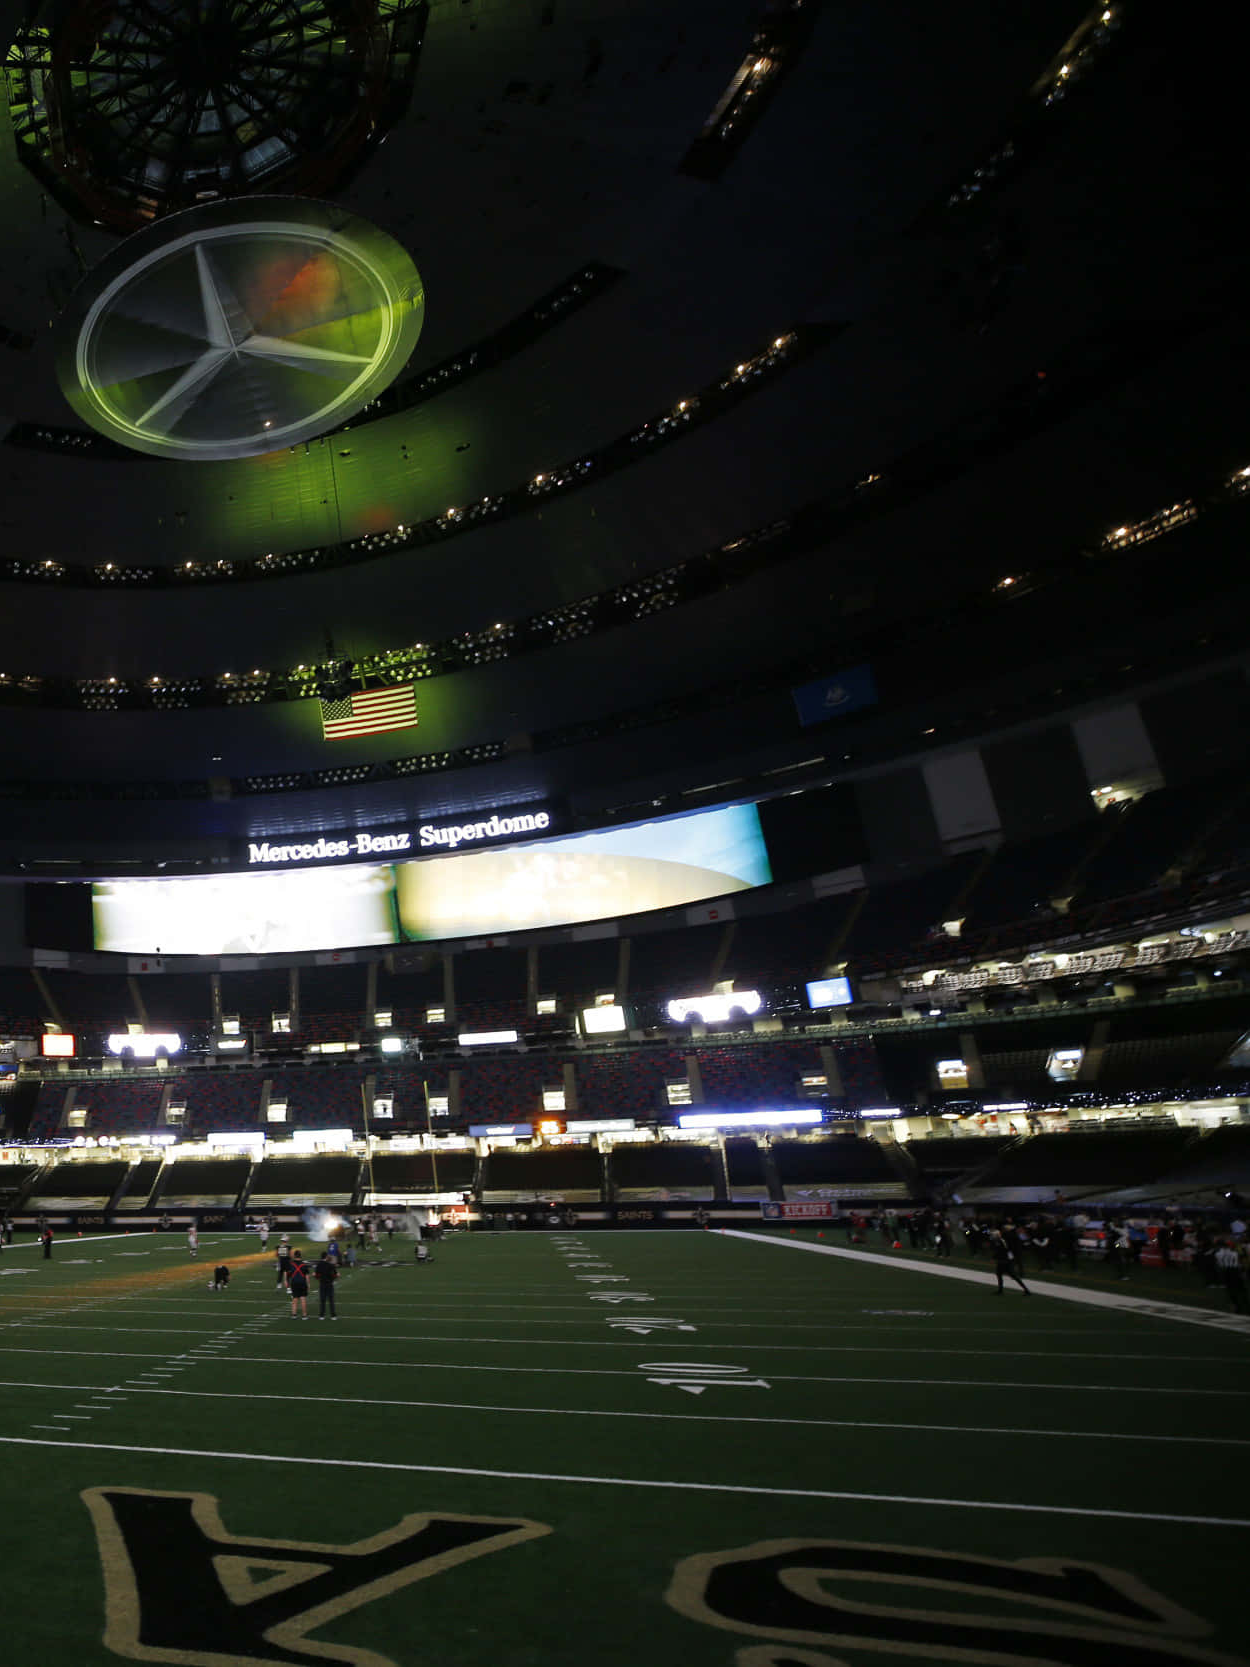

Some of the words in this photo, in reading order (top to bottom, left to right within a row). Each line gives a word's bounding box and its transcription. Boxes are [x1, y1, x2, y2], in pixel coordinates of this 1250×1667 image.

[247, 832, 411, 865] Mercedes-Benz
[418, 811, 550, 847] Superdome
[637, 1362, 772, 1390] 10
